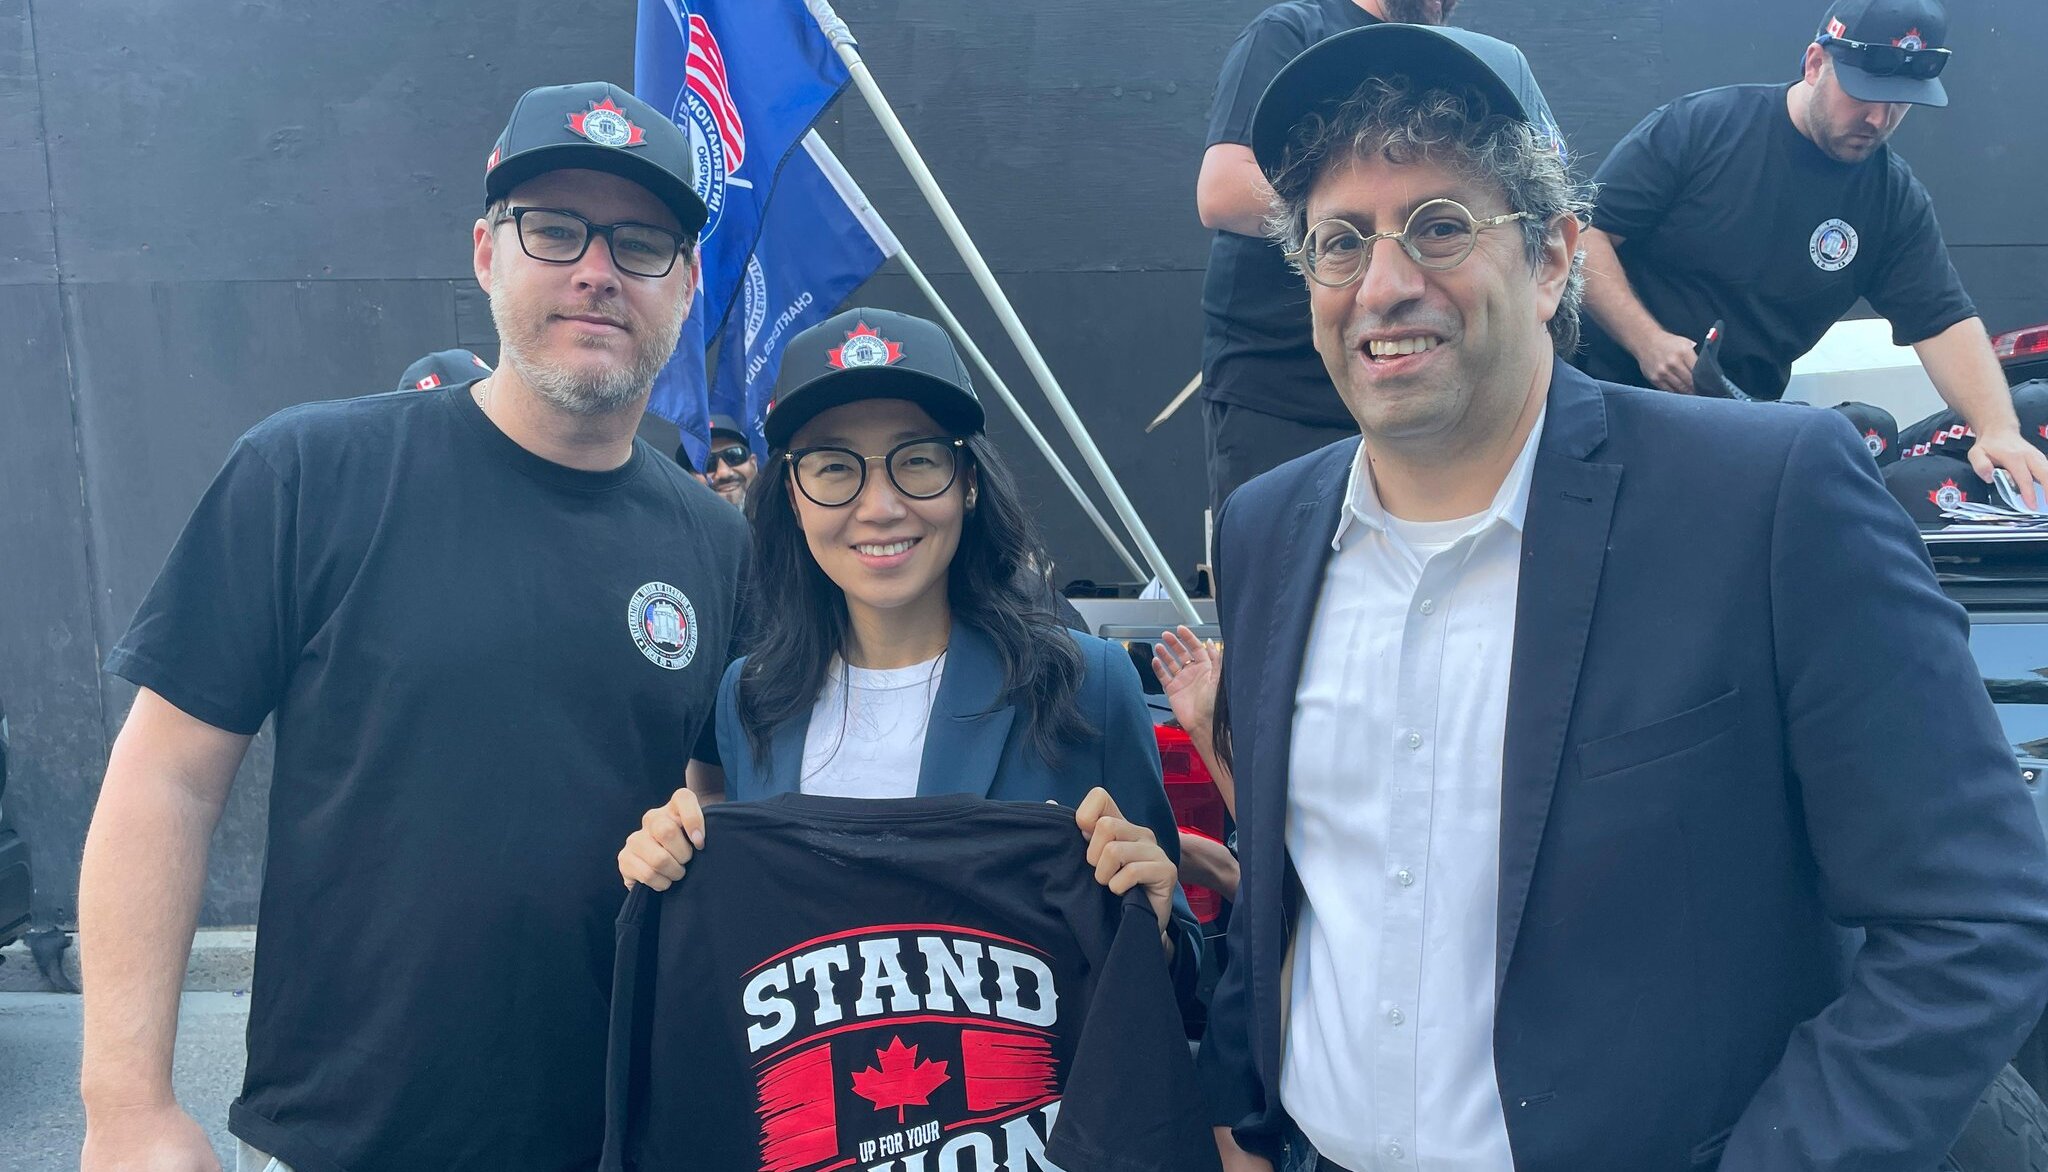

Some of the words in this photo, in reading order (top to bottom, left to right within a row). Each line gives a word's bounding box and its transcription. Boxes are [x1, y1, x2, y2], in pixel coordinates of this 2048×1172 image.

[742, 936, 1060, 1053] STAND
[859, 1139, 876, 1163] UP
[879, 1132, 904, 1157] FOR
[905, 1120, 940, 1150] YOUR
